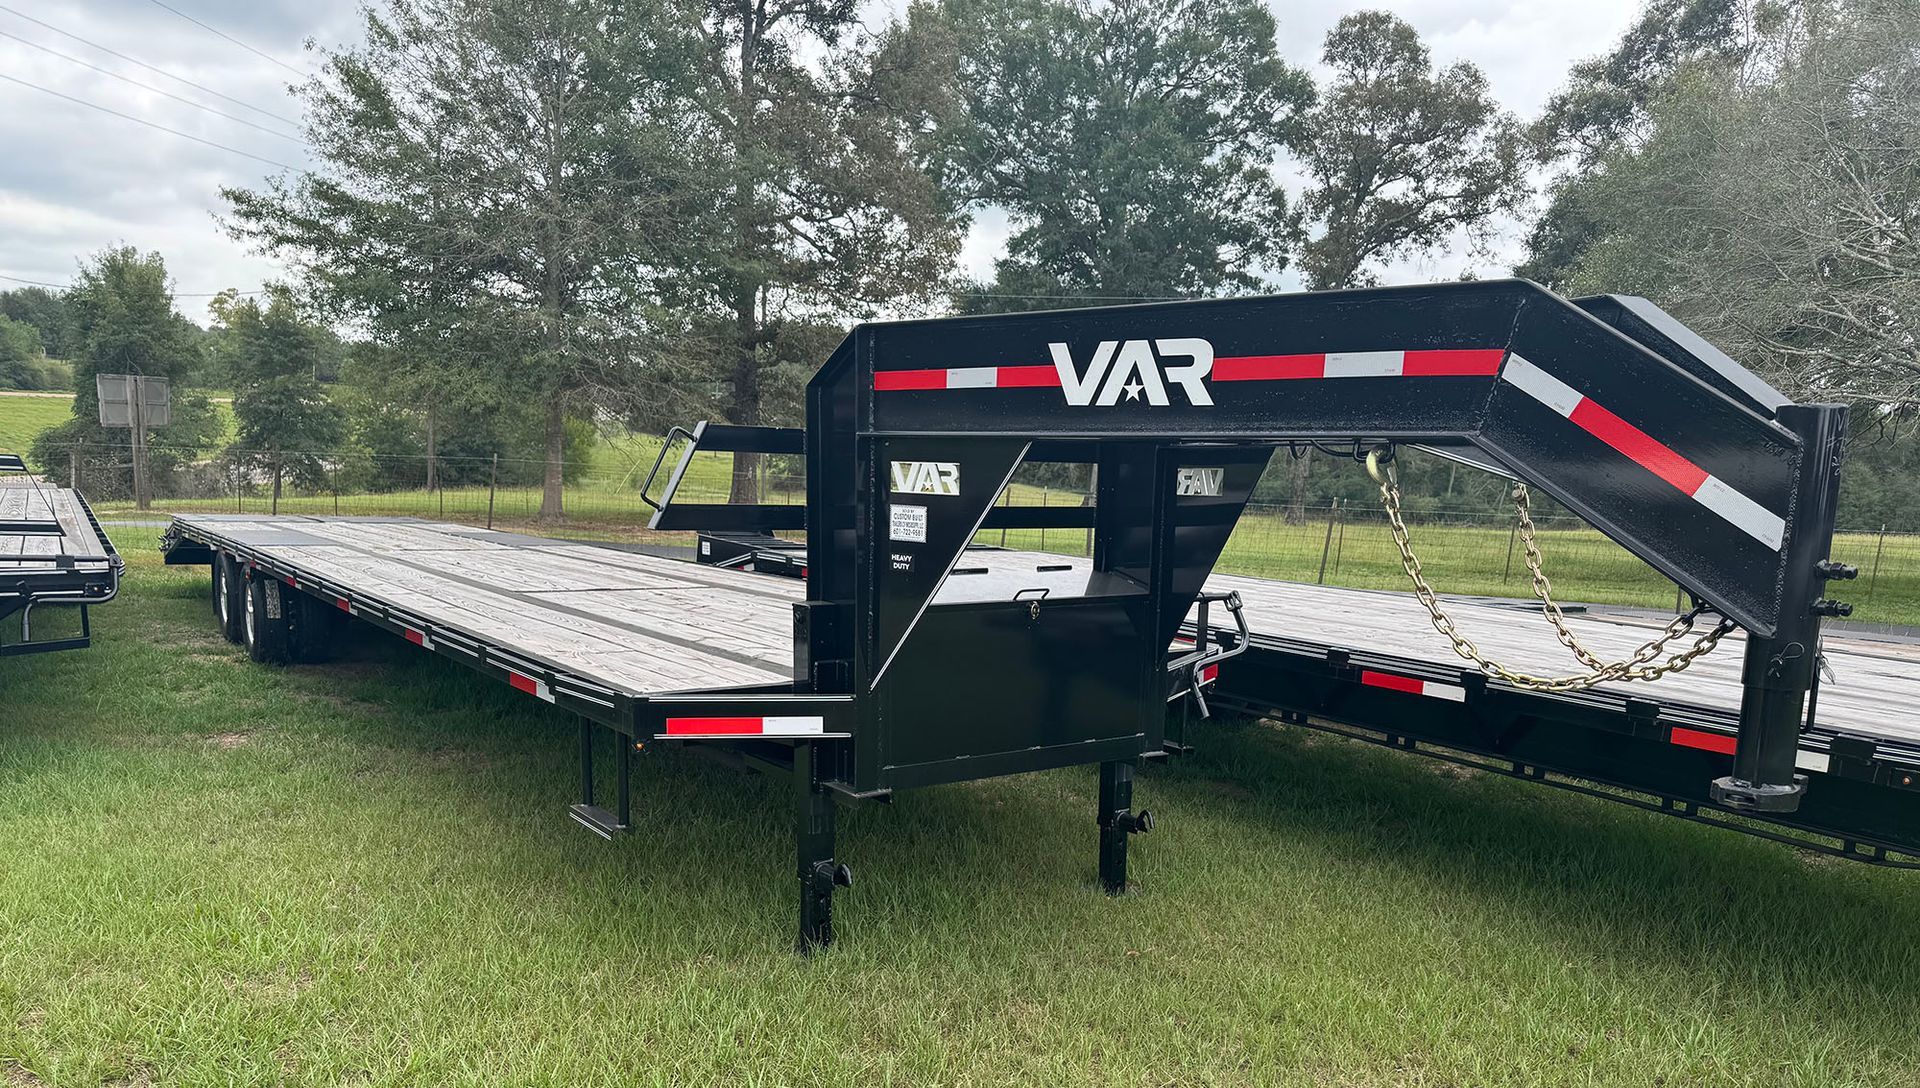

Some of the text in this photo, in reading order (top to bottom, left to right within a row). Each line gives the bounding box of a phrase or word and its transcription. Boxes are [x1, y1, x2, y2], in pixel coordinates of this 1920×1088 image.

[1048, 338, 1214, 406] VAR
[891, 461, 960, 496] VAR
[893, 512, 912, 520] CUSTOM
[891, 554, 912, 562] HEAVY
[893, 562, 910, 570] DUTY
